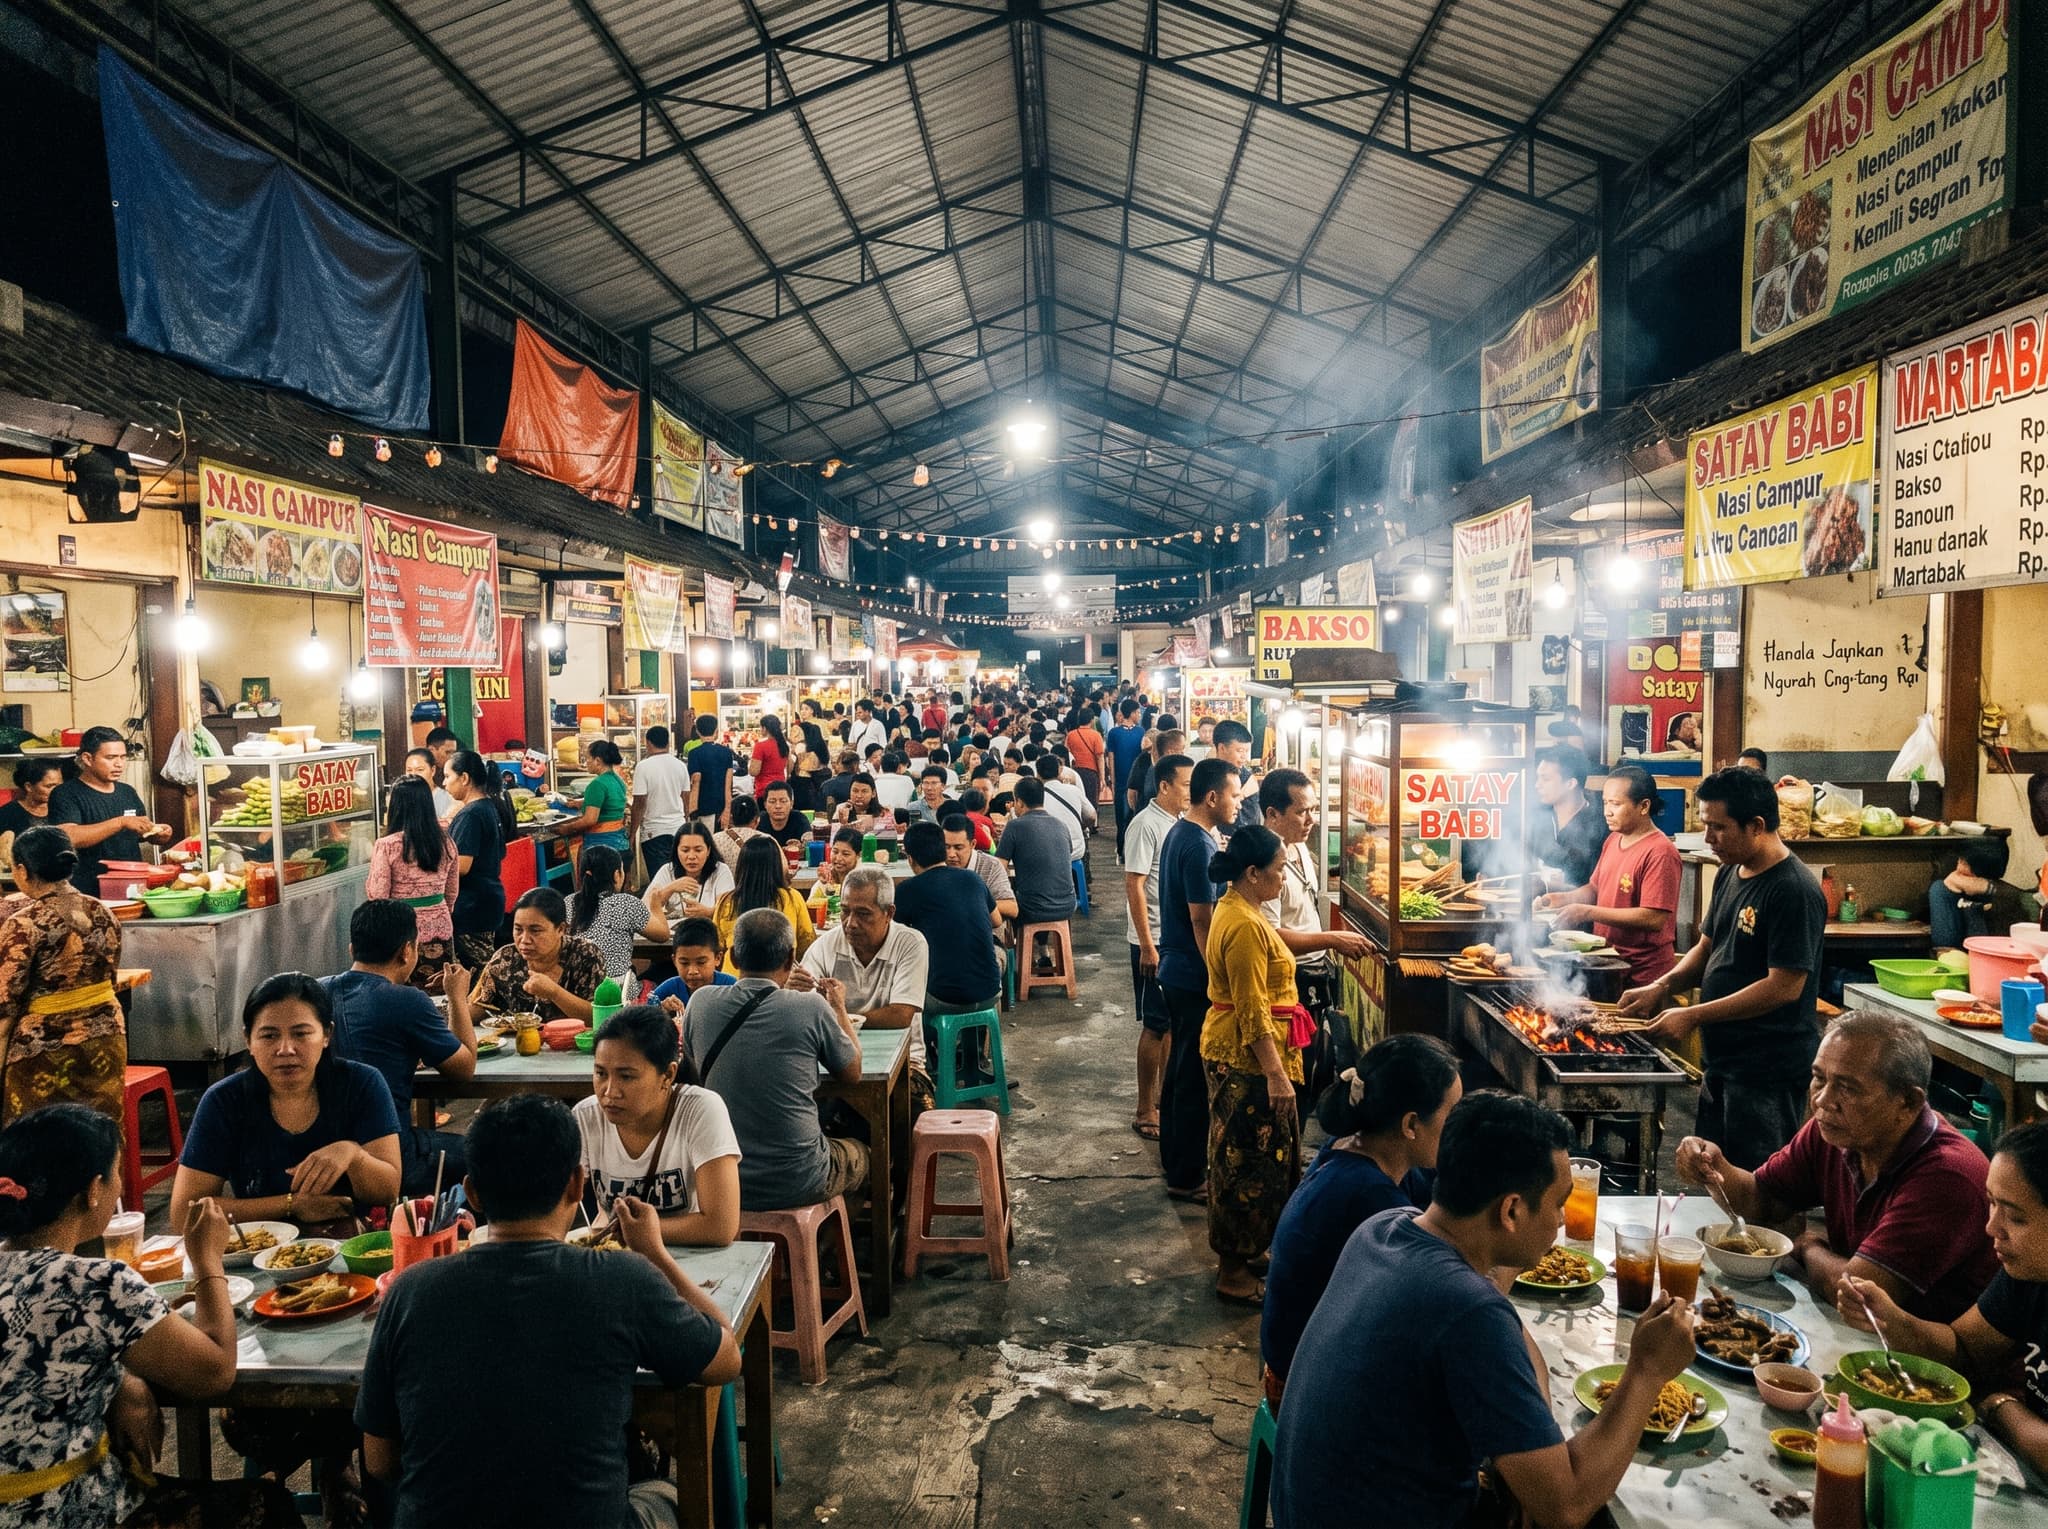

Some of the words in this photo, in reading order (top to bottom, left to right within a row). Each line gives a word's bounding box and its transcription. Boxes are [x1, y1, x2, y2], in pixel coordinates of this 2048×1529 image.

[1802, 63, 1876, 178] NASI
[1855, 178, 1889, 219] Nasi
[1895, 140, 1962, 196] Campur
[1853, 205, 1903, 253] Kemili
[1908, 175, 1970, 225] Segran
[1695, 412, 1780, 490] SATAY
[1785, 378, 1867, 465] BABI
[1895, 442, 1928, 471] Nasi
[2021, 417, 2048, 444] Rp
[206, 469, 266, 517] NASI
[272, 487, 356, 535] CAMPUR
[1717, 485, 1751, 519] Nasi
[1756, 472, 1824, 510] Campur
[1895, 475, 1942, 501] Bakso
[1894, 503, 1954, 530] Banoun
[371, 515, 419, 560] Nasi
[422, 528, 491, 576] Campur
[1894, 536, 1932, 558] Hanu
[1938, 524, 1988, 553] danak
[1893, 559, 1966, 588] Martabak
[2018, 551, 2048, 579] Rp.
[1264, 615, 1370, 641] BAKSO
[1642, 675, 1698, 703] Satay
[1764, 670, 1816, 697] Ngurah
[298, 758, 360, 790] SATAY
[1406, 772, 1517, 805] SATAY
[307, 786, 352, 816] BABI
[1419, 808, 1502, 840] BABI
